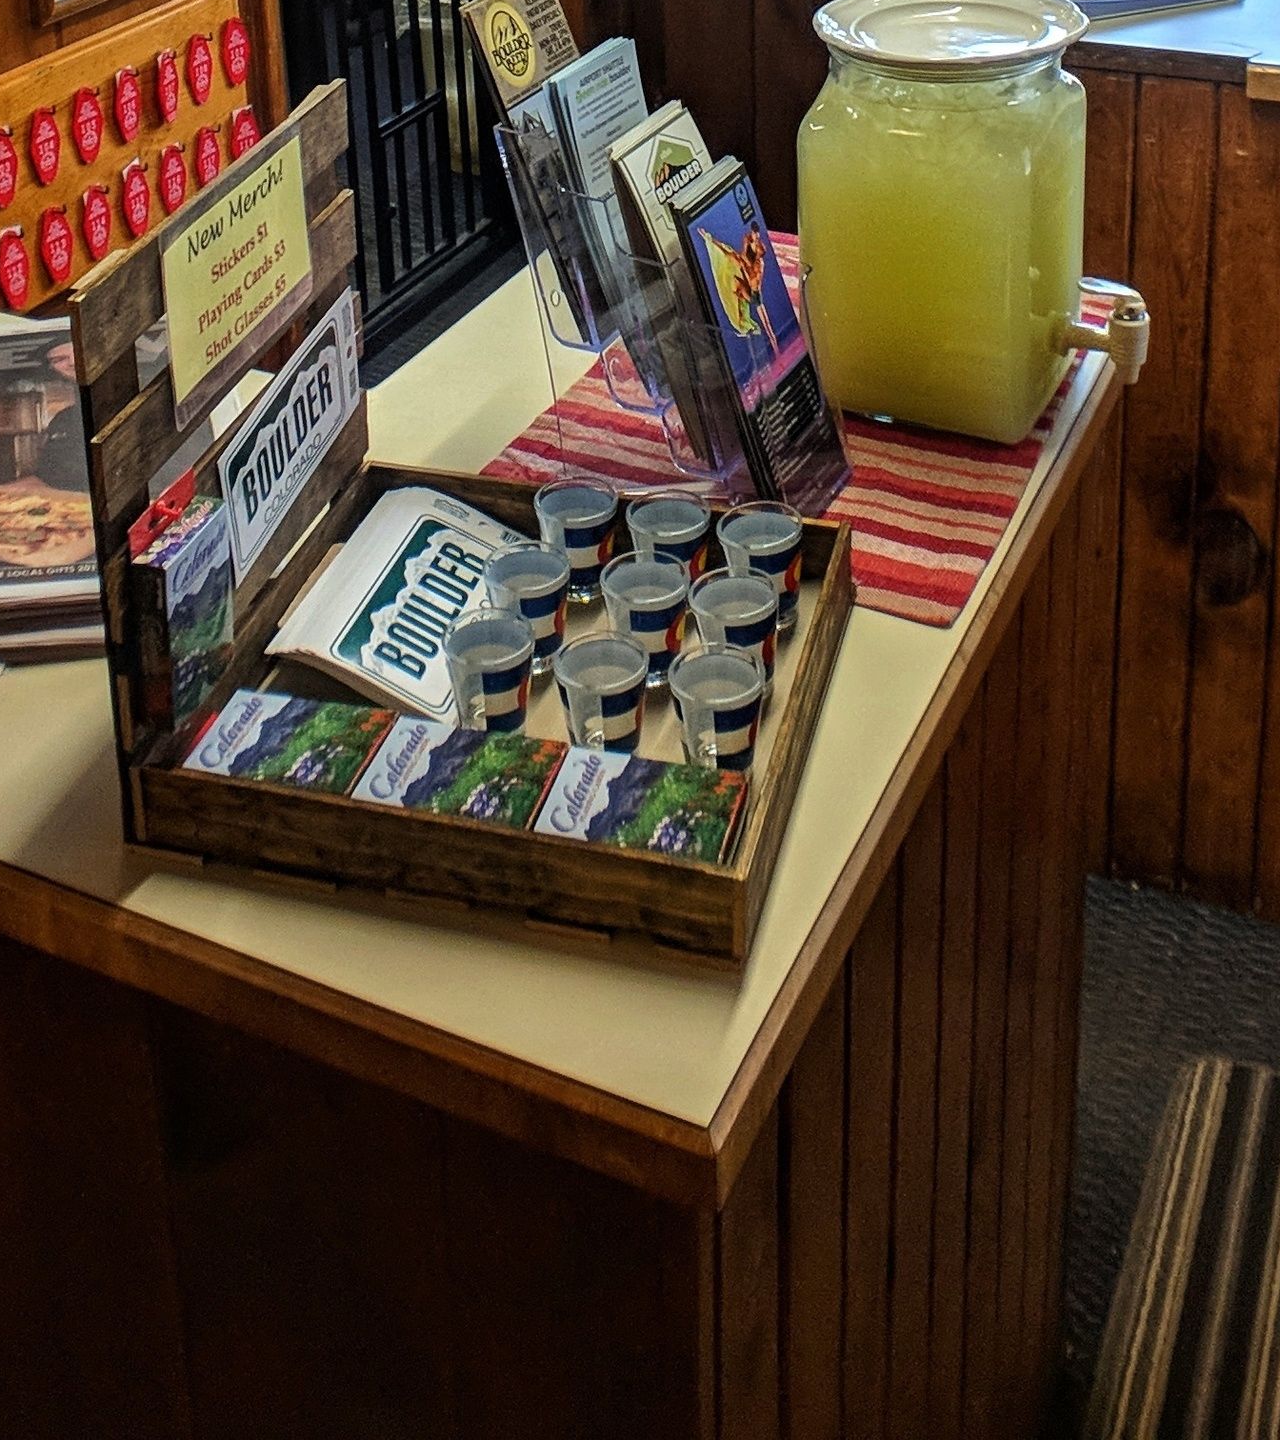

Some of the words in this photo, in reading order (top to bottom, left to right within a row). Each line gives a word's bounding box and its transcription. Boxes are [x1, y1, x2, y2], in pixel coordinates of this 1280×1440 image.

[491, 32, 533, 68] BOULDER
[506, 50, 529, 71] BEER
[579, 68, 602, 88] AIRPORT
[187, 216, 224, 263] New
[229, 159, 284, 227] Merch!
[655, 159, 702, 204] BOULDER
[198, 286, 242, 335] Playing
[243, 255, 273, 291] Cards
[274, 239, 286, 262] $3
[211, 237, 256, 284] Stickers
[256, 222, 269, 247] $1
[206, 329, 232, 365] Shot
[234, 292, 275, 336] Glasses
[275, 273, 287, 298] $5
[241, 362, 336, 526] BOULDER
[263, 432, 323, 525] COLORADO
[7, 569, 44, 578] LOCAL
[46, 567, 75, 576] GIFTS
[372, 540, 487, 680] BOULDER
[200, 694, 264, 769] Colorado
[370, 720, 429, 801] Colorado
[550, 751, 604, 835] Colorado
